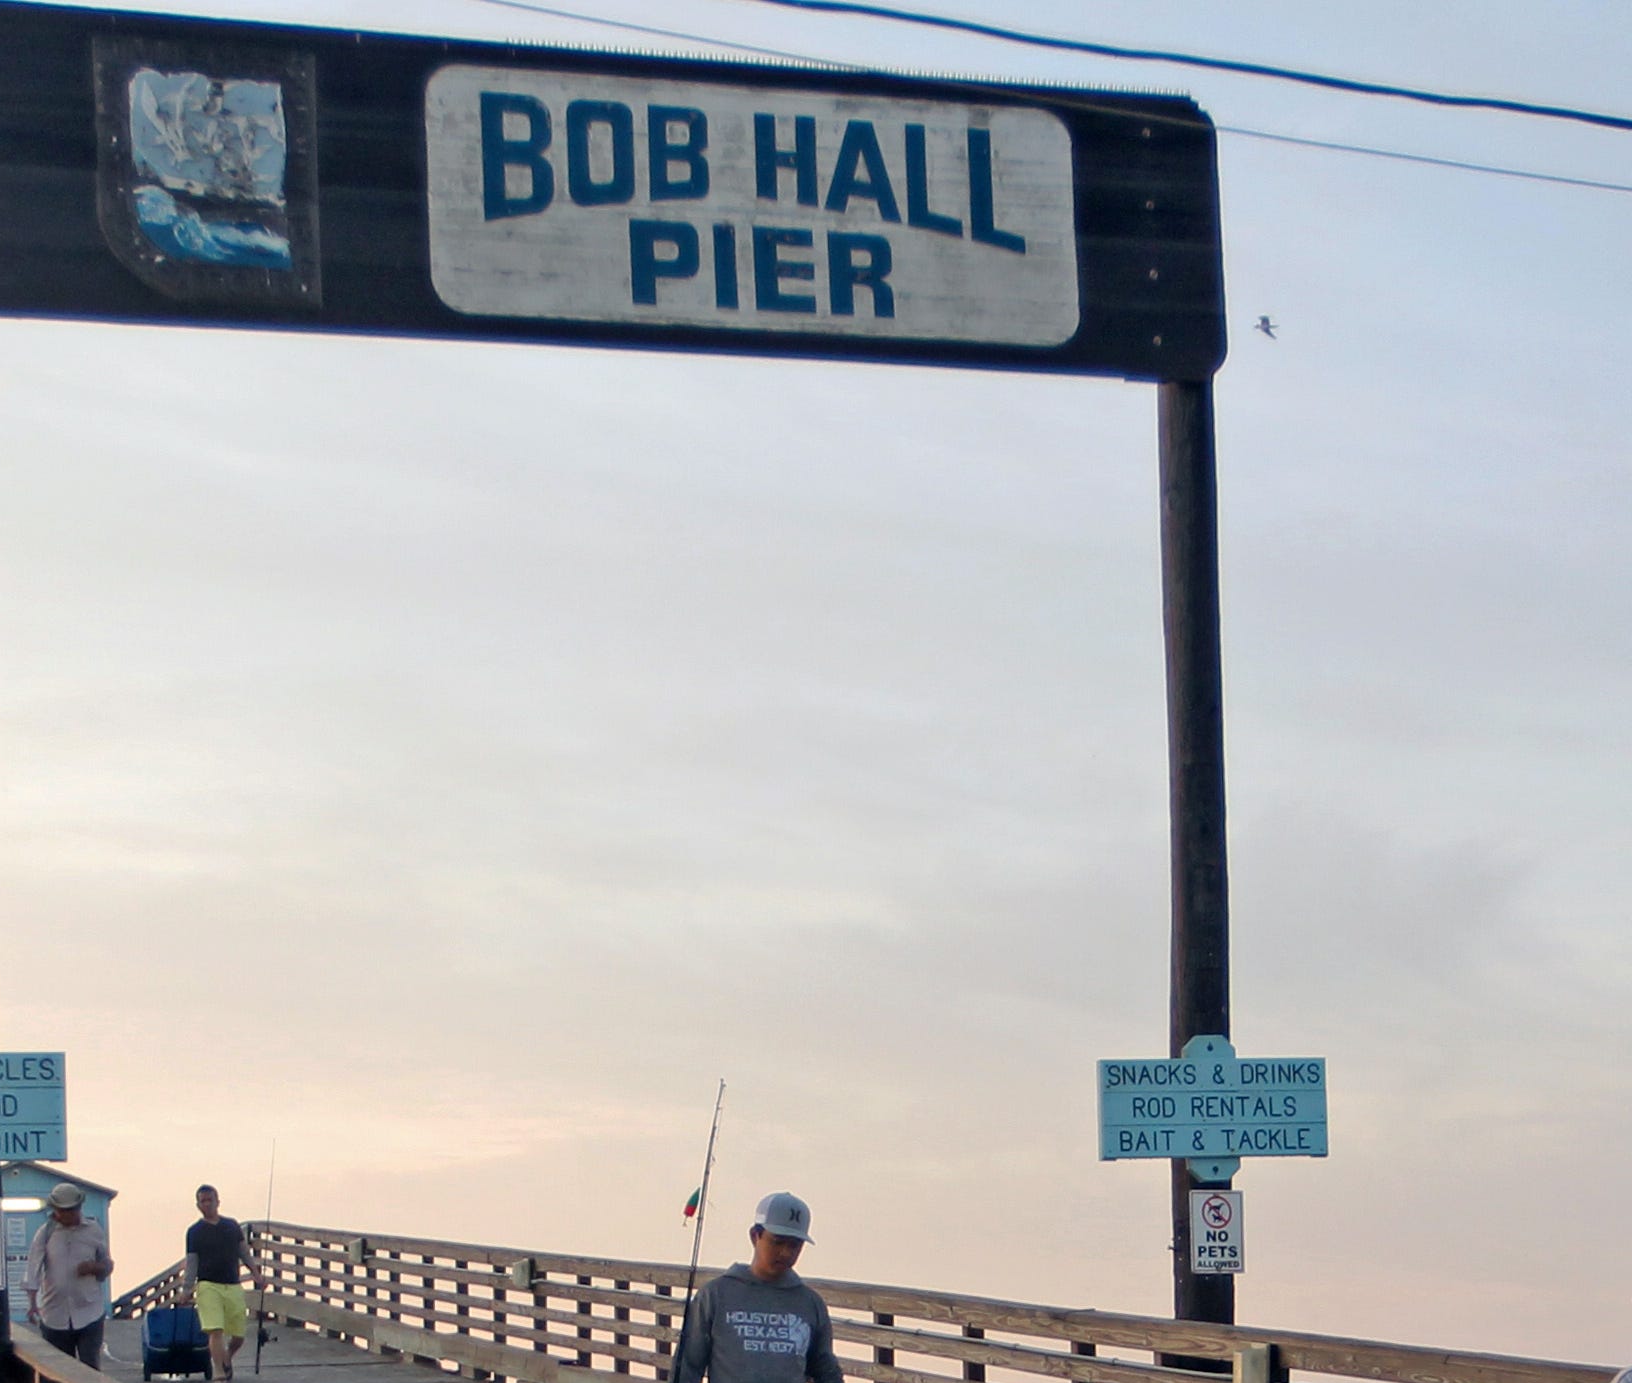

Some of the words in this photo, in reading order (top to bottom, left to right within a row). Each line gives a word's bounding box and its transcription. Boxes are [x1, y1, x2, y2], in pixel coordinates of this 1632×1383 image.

[480, 91, 710, 222] BOB
[754, 112, 1027, 256] HALL
[628, 218, 895, 318] PIER
[1107, 1063, 1196, 1086] SNACKS
[1212, 1063, 1225, 1085] &
[1240, 1063, 1321, 1085] DRINKS
[1132, 1097, 1176, 1118] ROD
[1191, 1096, 1297, 1118] RENTALS
[1119, 1130, 1175, 1151] BAIT
[1192, 1130, 1205, 1151] &
[1221, 1128, 1310, 1150] TACKLE
[1206, 1230, 1228, 1242] NO
[1198, 1245, 1237, 1258] PETS
[1197, 1260, 1240, 1268] ALLOWED
[726, 1311, 788, 1325] HOUSTON
[733, 1325, 788, 1339] TEXAS
